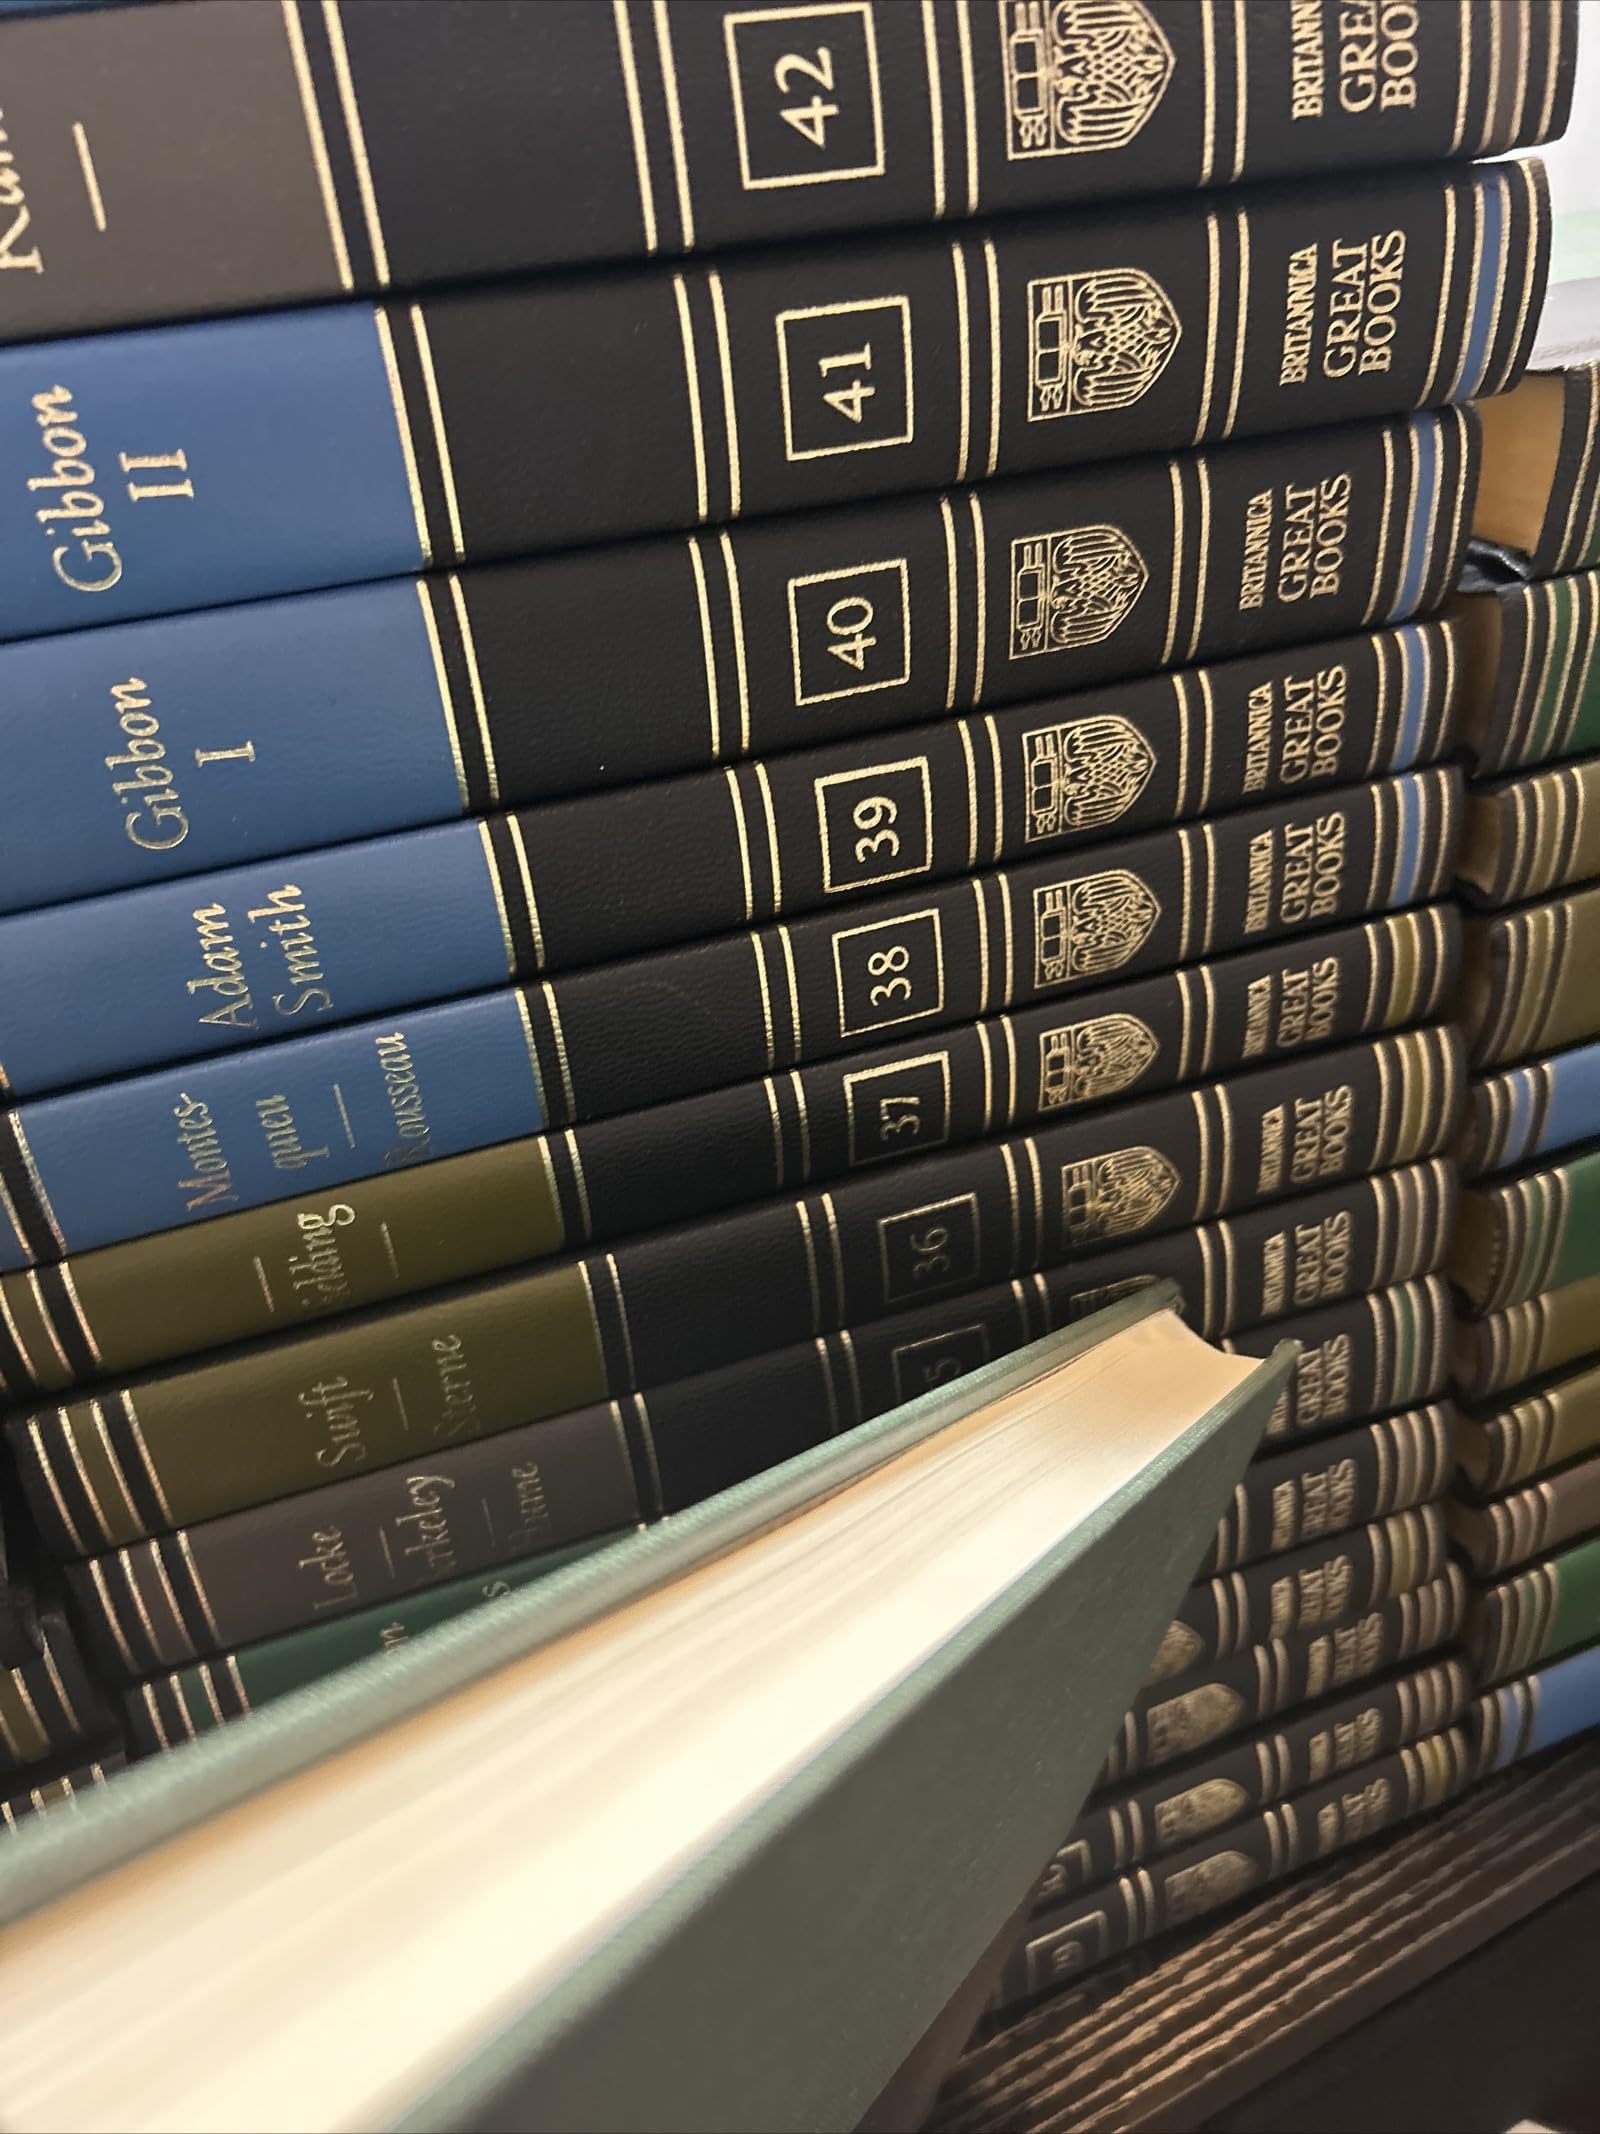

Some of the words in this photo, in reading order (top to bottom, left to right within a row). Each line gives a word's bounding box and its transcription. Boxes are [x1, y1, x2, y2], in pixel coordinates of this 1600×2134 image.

[774, 46, 837, 149] 42
[1291, 0, 1324, 120] BRITANN
[1338, 0, 1378, 113] GRE
[1380, 0, 1419, 112] BOO
[1278, 243, 1320, 387] BRITANNICA
[1322, 240, 1369, 380] GREAT
[1360, 228, 1407, 376] BOOKS
[821, 340, 874, 425] 41
[27, 384, 123, 592] Gibbon
[120, 449, 195, 500] II
[1239, 489, 1274, 610] BRITANNICA
[1277, 482, 1320, 603] GREAT
[1310, 473, 1353, 598] BOOKS
[825, 596, 877, 673] 40
[105, 676, 189, 851] Gibbon
[196, 739, 256, 767] I
[1242, 681, 1273, 792] BRITANNICA
[1279, 675, 1314, 783] GREAT
[1310, 664, 1346, 777] BOOKS
[854, 795, 900, 863] 39
[1280, 823, 1314, 923] GREAT
[1310, 811, 1345, 917] BOOKS
[186, 902, 260, 1031] Adam
[247, 883, 333, 1016] Smith
[869, 945, 911, 1008] 38
[1305, 956, 1339, 1040] BOOKS
[1276, 968, 1310, 1047] GREAT
[172, 1092, 239, 1212] Montes-
[880, 1094, 921, 1140] 37
[1289, 1097, 1322, 1183] GREAT
[1319, 1085, 1353, 1175] BOOKS
[909, 1227, 951, 1279] 36
[1293, 1224, 1322, 1304] GREAT
[1322, 1210, 1352, 1297] BOOKS
[297, 1375, 375, 1467] Swift
[297, 1525, 359, 1610] Locke
